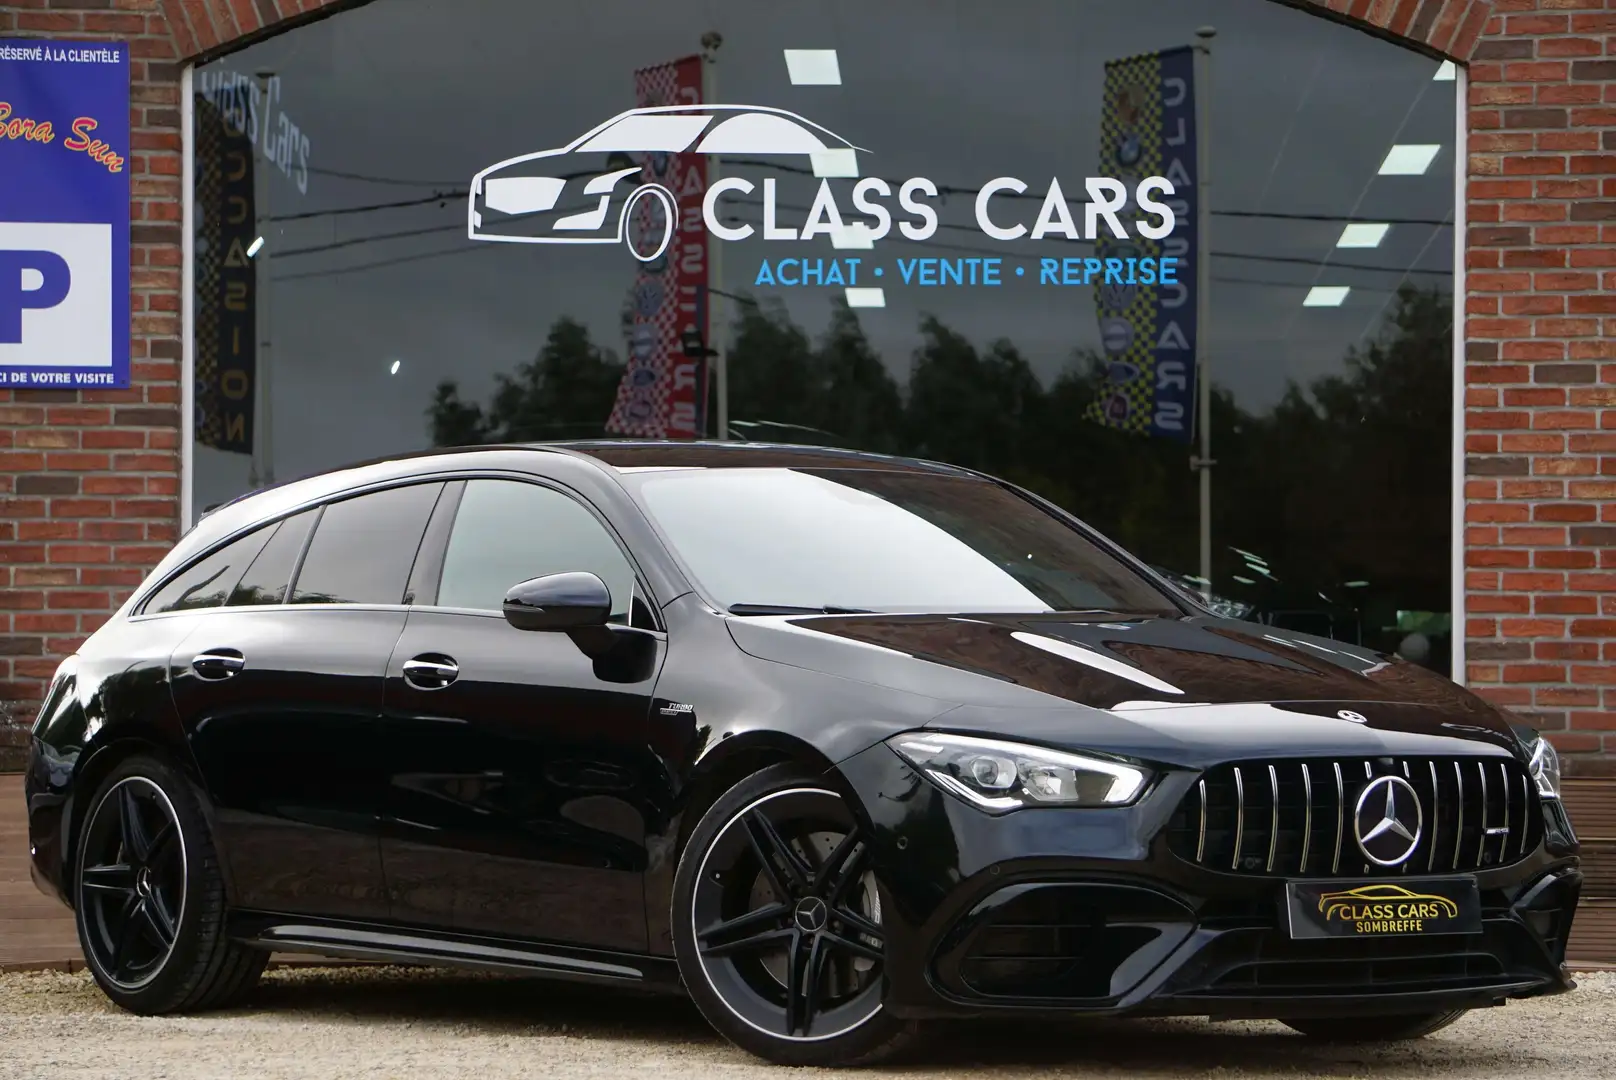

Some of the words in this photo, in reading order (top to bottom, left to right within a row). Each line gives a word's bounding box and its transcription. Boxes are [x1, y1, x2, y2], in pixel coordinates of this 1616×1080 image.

[0, 45, 43, 61] RÉSERVÉ
[44, 46, 52, 61] À
[53, 49, 67, 62] LA
[68, 48, 120, 63] CLIENTÈLE
[64, 117, 124, 172] Sun
[263, 76, 310, 196] Cars
[702, 176, 938, 241] CLASS
[975, 176, 1176, 241] CARS
[754, 257, 862, 286] ACHAT
[897, 257, 1002, 286] VENTE
[1040, 257, 1178, 286] REPRISE
[0, 250, 71, 344] P
[11, 372, 28, 383] DE
[31, 372, 71, 384] VOTRE
[75, 373, 114, 384] VISITE
[1339, 904, 1394, 920] CLASS
[1397, 903, 1439, 919] CARS
[1356, 919, 1423, 934] SOMBREFFE
